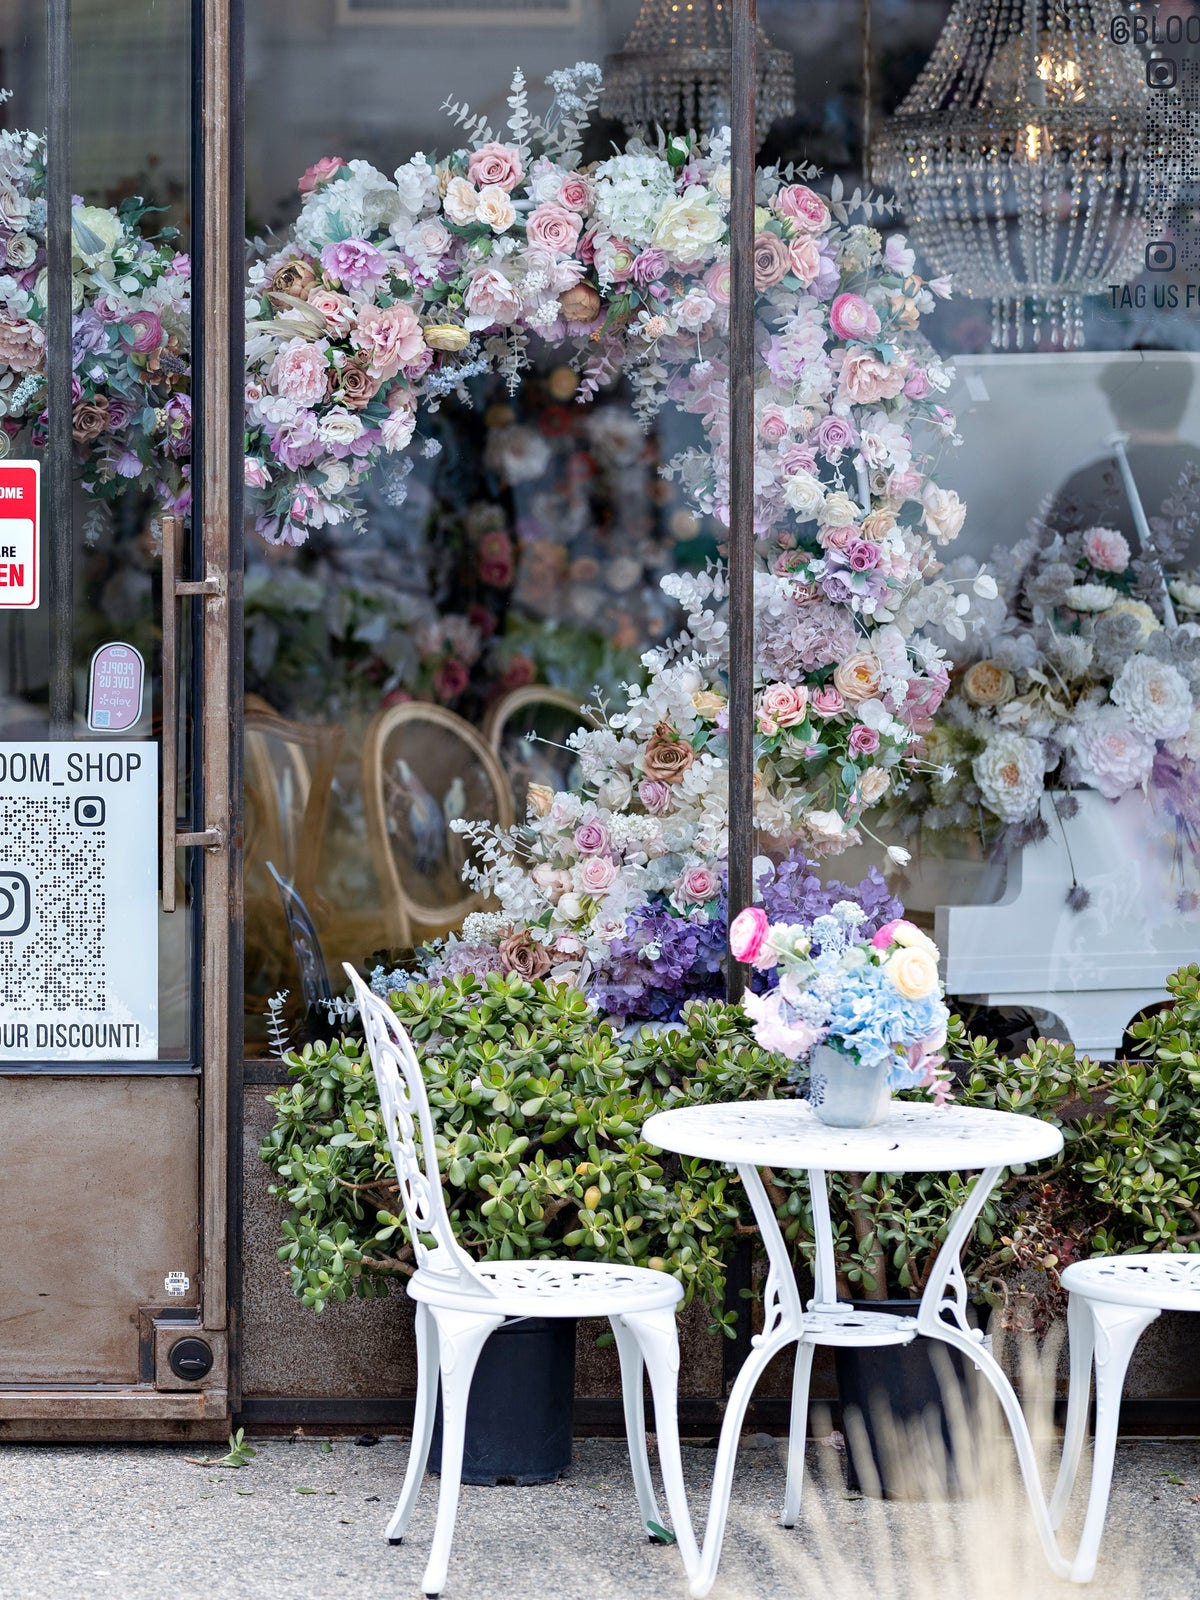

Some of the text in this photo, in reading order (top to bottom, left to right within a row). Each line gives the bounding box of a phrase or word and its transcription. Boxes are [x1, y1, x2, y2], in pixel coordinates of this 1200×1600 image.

[1108, 284, 1200, 309] TAG US F
[36, 1023, 140, 1048] DISCOUNT!
